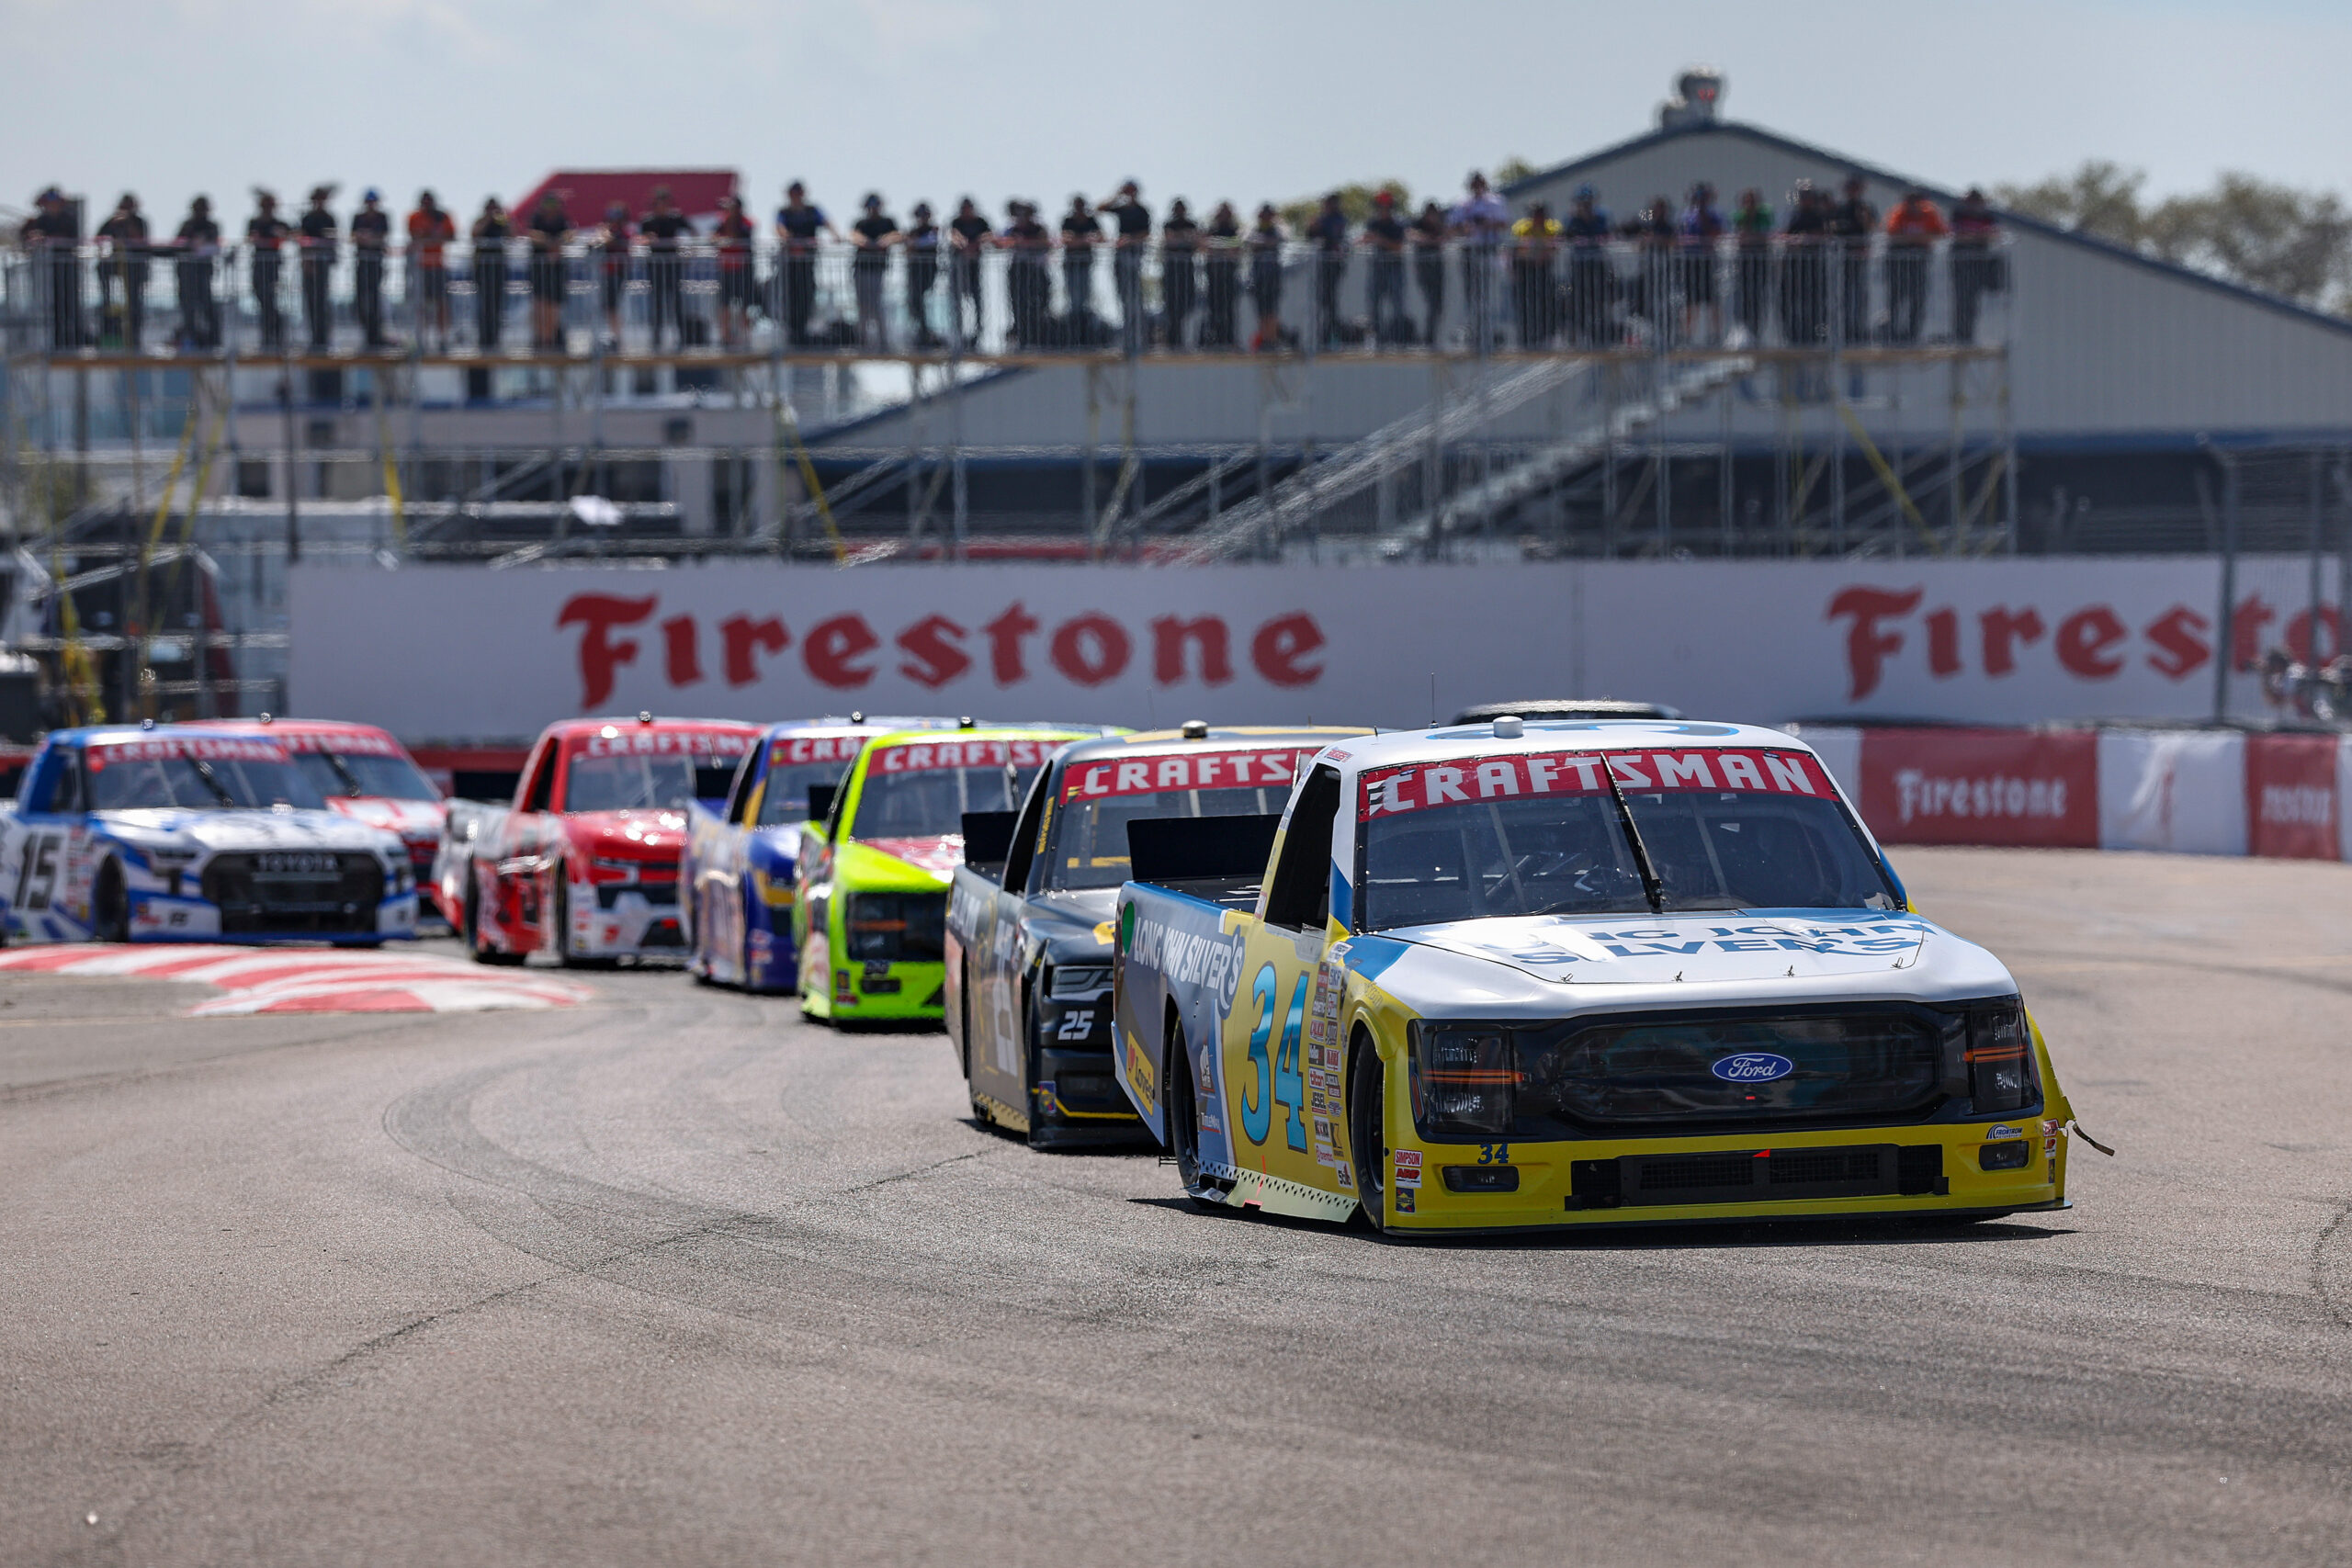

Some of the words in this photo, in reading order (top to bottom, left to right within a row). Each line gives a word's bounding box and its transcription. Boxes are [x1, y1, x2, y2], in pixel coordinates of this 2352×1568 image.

[558, 591, 1327, 711] Firestone
[1381, 752, 1816, 813] CRAFTSMAN
[1894, 769, 2068, 827] Firestone
[14, 831, 63, 909] 15
[257, 853, 339, 873] TOYOTA
[1133, 916, 1164, 971] LONG
[1329, 965, 1342, 987] SKF
[1057, 1010, 1095, 1041] 25
[1240, 959, 1311, 1156] 34
[1727, 1056, 1777, 1077] Ford
[1396, 1151, 1421, 1166] SIMPSON
[1476, 1143, 1510, 1165] 34
[1396, 1168, 1420, 1179] ARP
